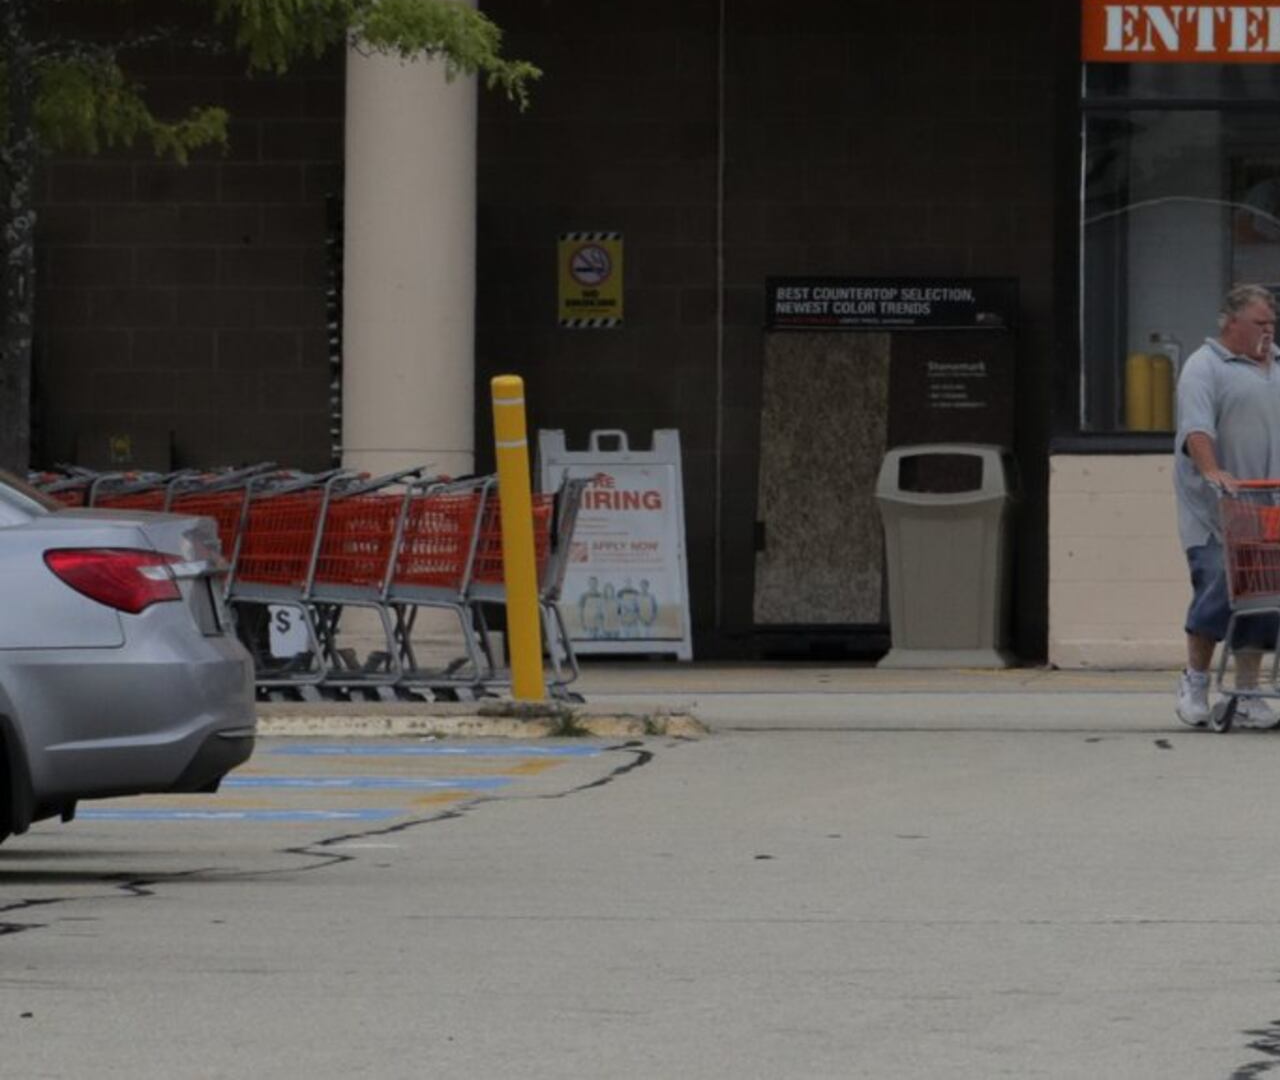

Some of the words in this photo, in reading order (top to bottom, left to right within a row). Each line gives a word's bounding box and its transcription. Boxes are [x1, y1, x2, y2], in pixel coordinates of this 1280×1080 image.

[776, 287, 810, 301] BEST
[812, 287, 897, 301] COUNTERTOP
[901, 287, 976, 303] SELECTION,
[776, 301, 829, 315] NEWEST
[833, 301, 876, 315] COLOR
[880, 302, 931, 315] TRENDS
[584, 490, 662, 510] IRING
